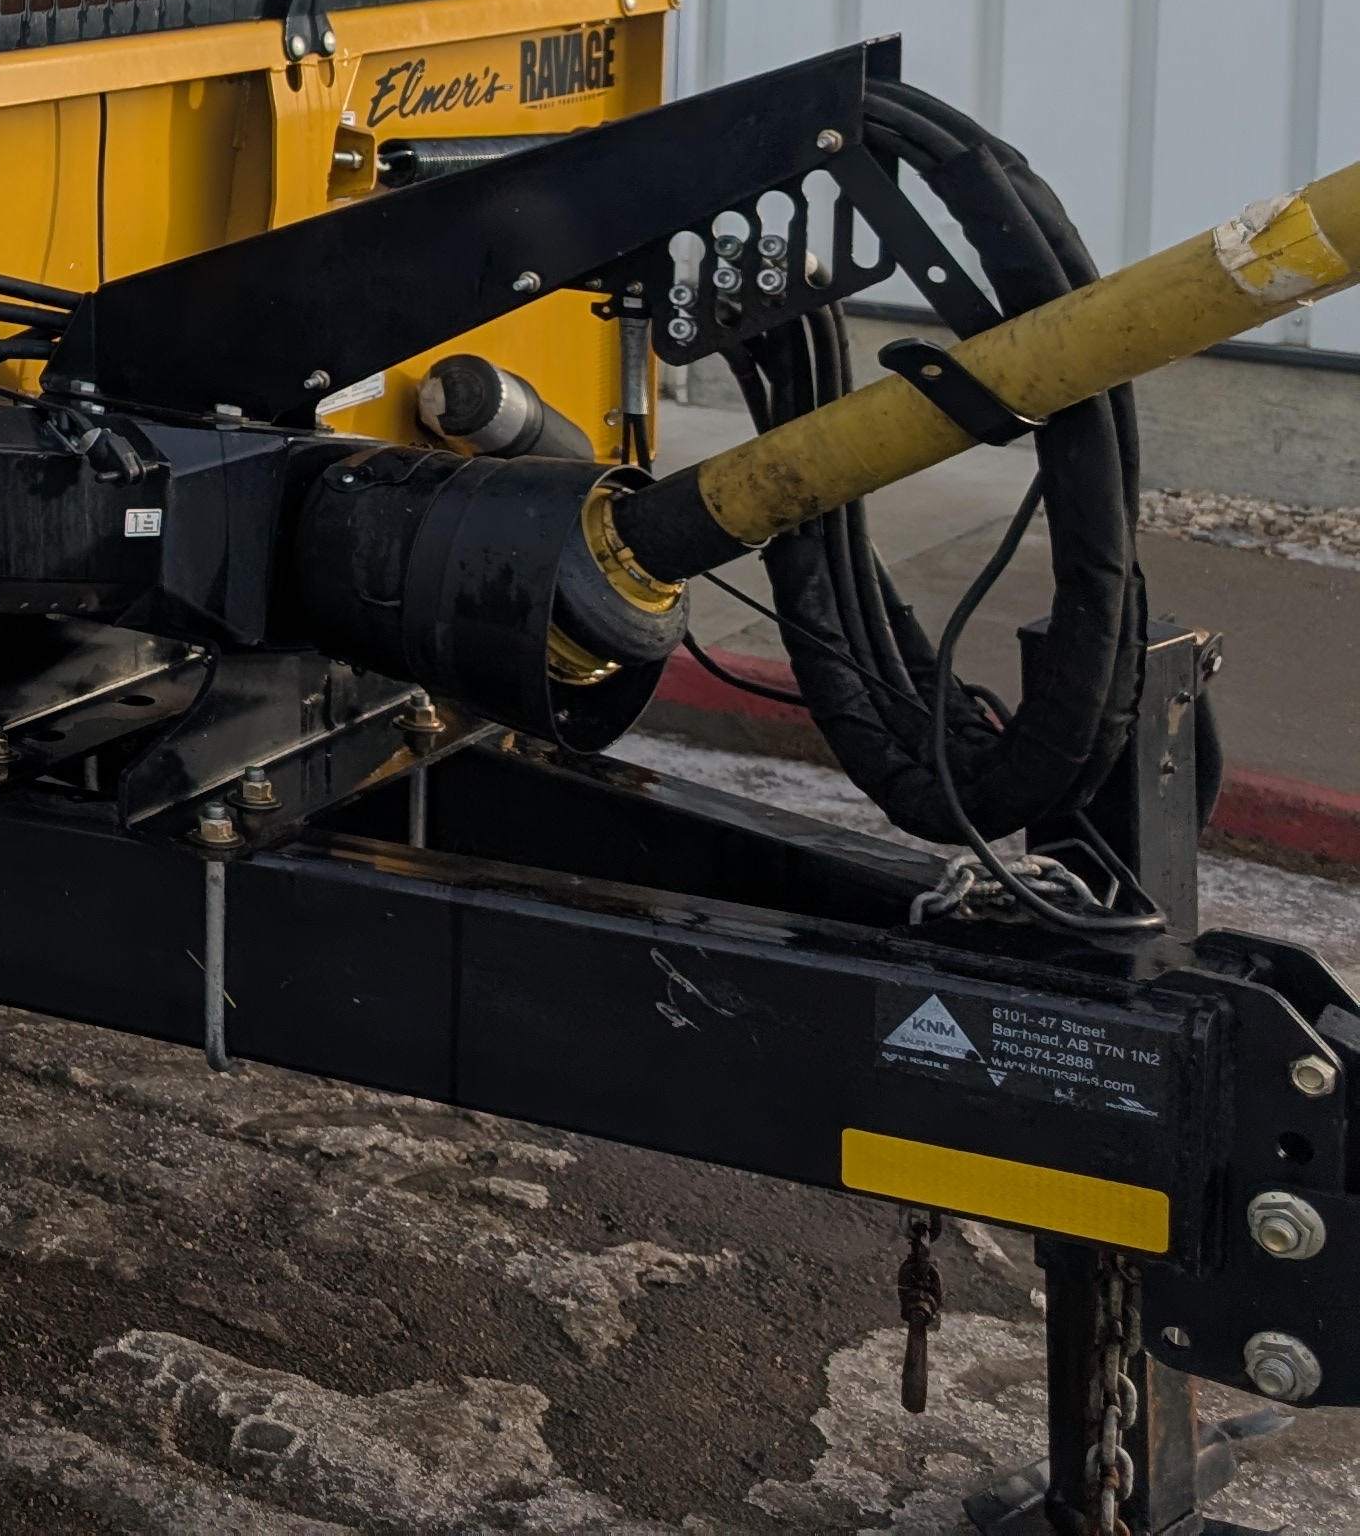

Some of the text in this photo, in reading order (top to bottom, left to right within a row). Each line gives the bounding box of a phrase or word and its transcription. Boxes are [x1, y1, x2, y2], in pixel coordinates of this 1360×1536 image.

[519, 27, 616, 105] RAVAGE
[366, 57, 514, 128] Elmer's
[911, 1016, 956, 1038] KNM
[992, 1007, 1107, 1040] 6101- 47 Street
[992, 1022, 1161, 1067] Barrhead, AB T7N 1N2
[992, 1039, 1094, 1071] 780-674-2888
[991, 1056, 1136, 1094] www.knmsales.com
